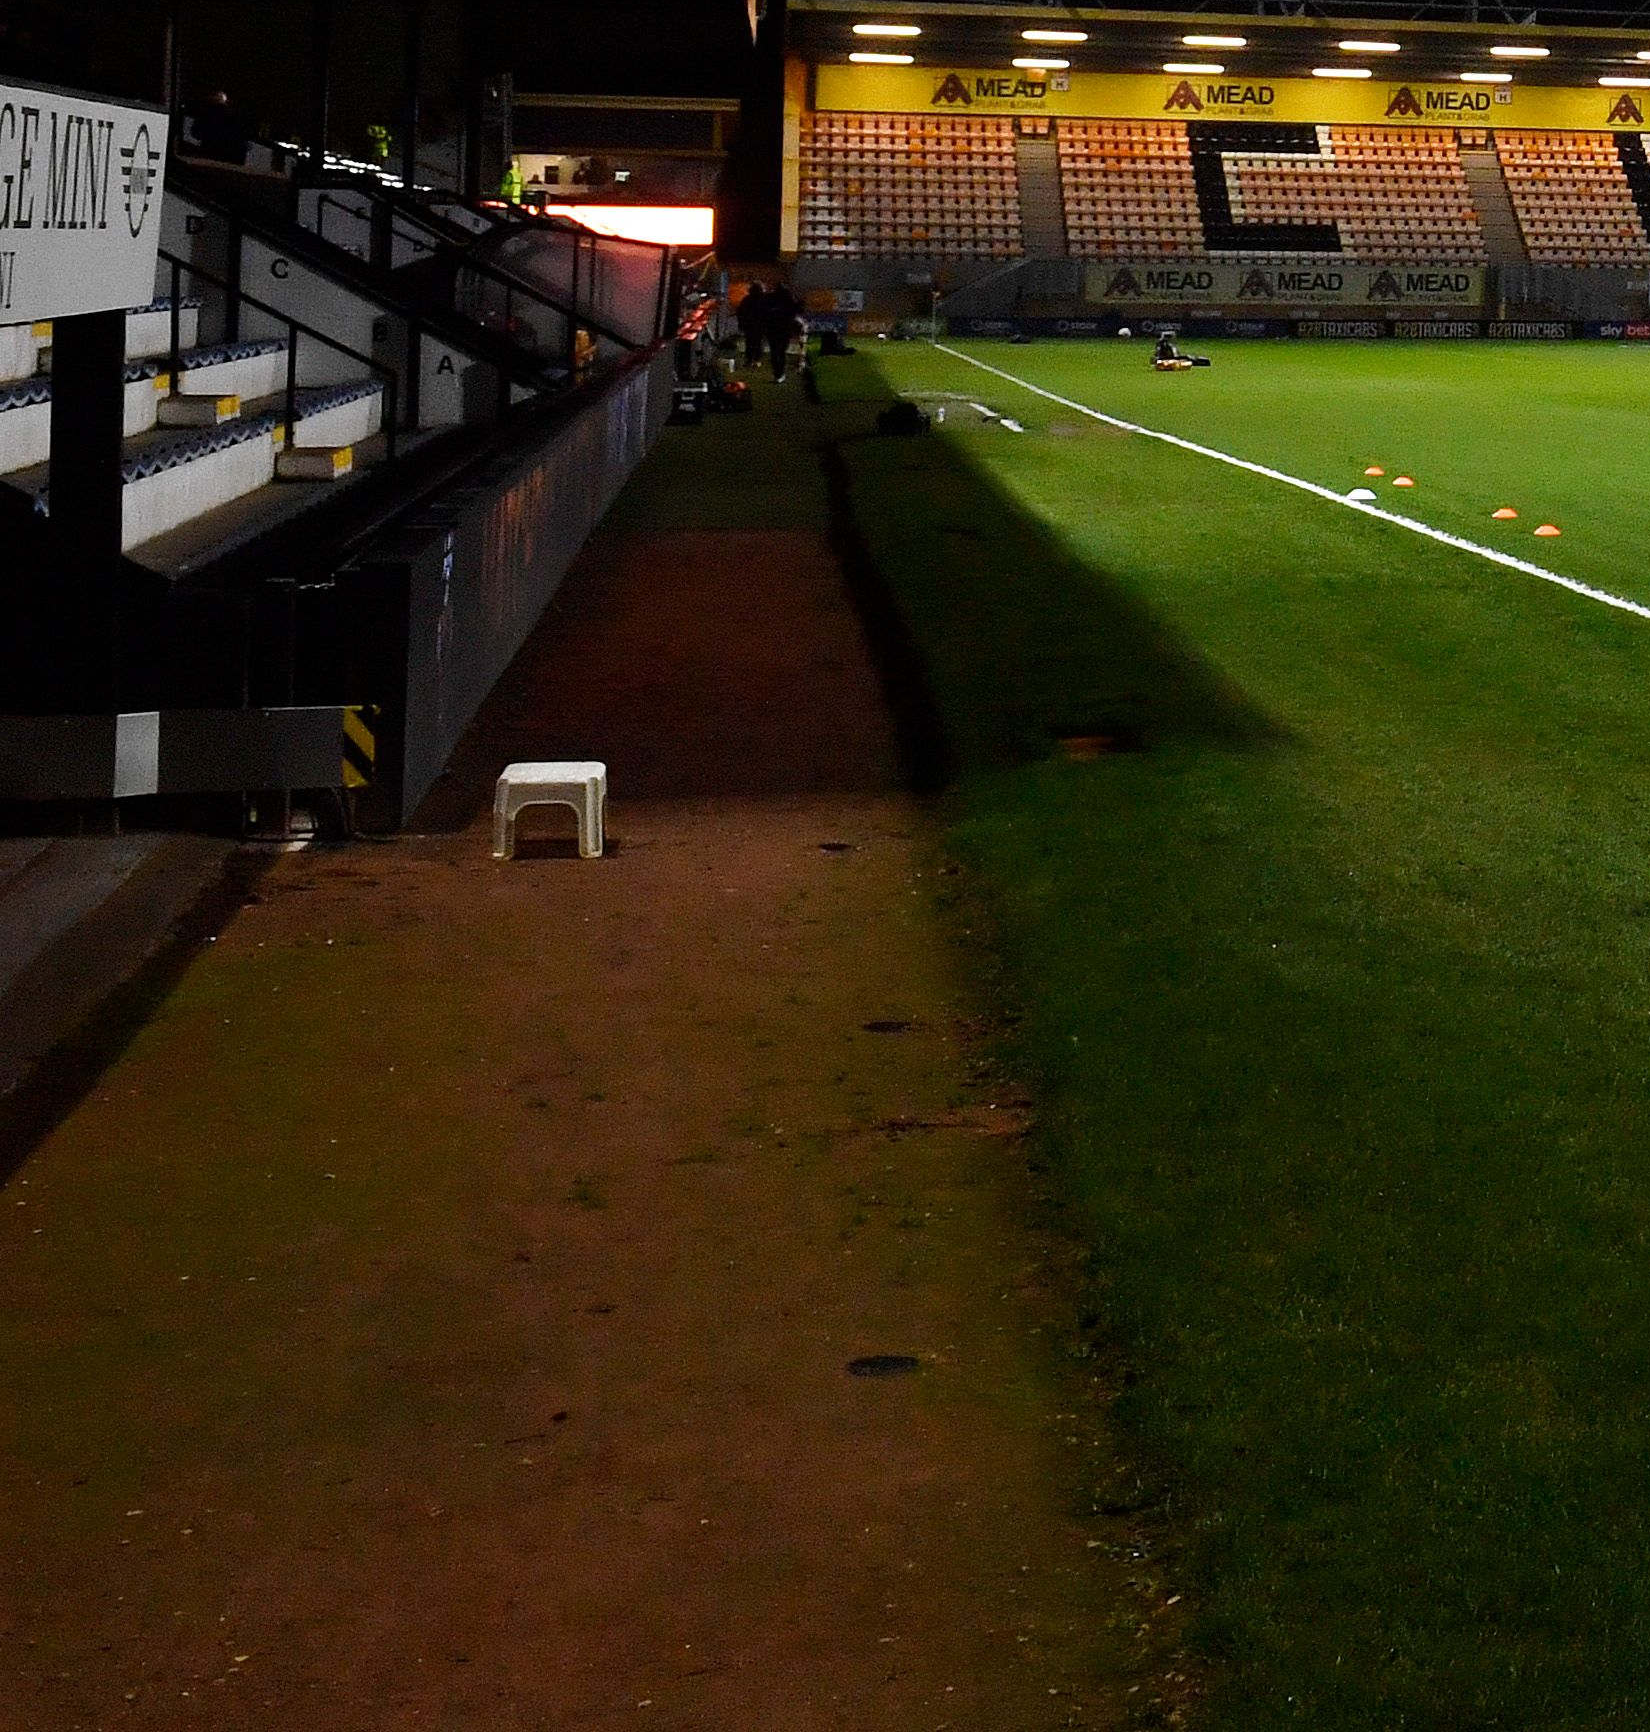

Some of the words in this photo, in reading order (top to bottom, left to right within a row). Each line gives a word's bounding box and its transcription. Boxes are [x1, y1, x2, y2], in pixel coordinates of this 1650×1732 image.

[976, 78, 1046, 98] MEAD
[1207, 86, 1274, 106] MEAD
[1426, 92, 1490, 111] MEAD
[42, 111, 115, 229] MINI
[1187, 122, 1342, 251] C
[271, 258, 288, 279] C
[1147, 271, 1213, 289] MEAD
[1278, 272, 1343, 290] MEAD
[1407, 274, 1469, 291] MEAD
[1600, 324, 1623, 338] sky
[438, 355, 454, 375] A
